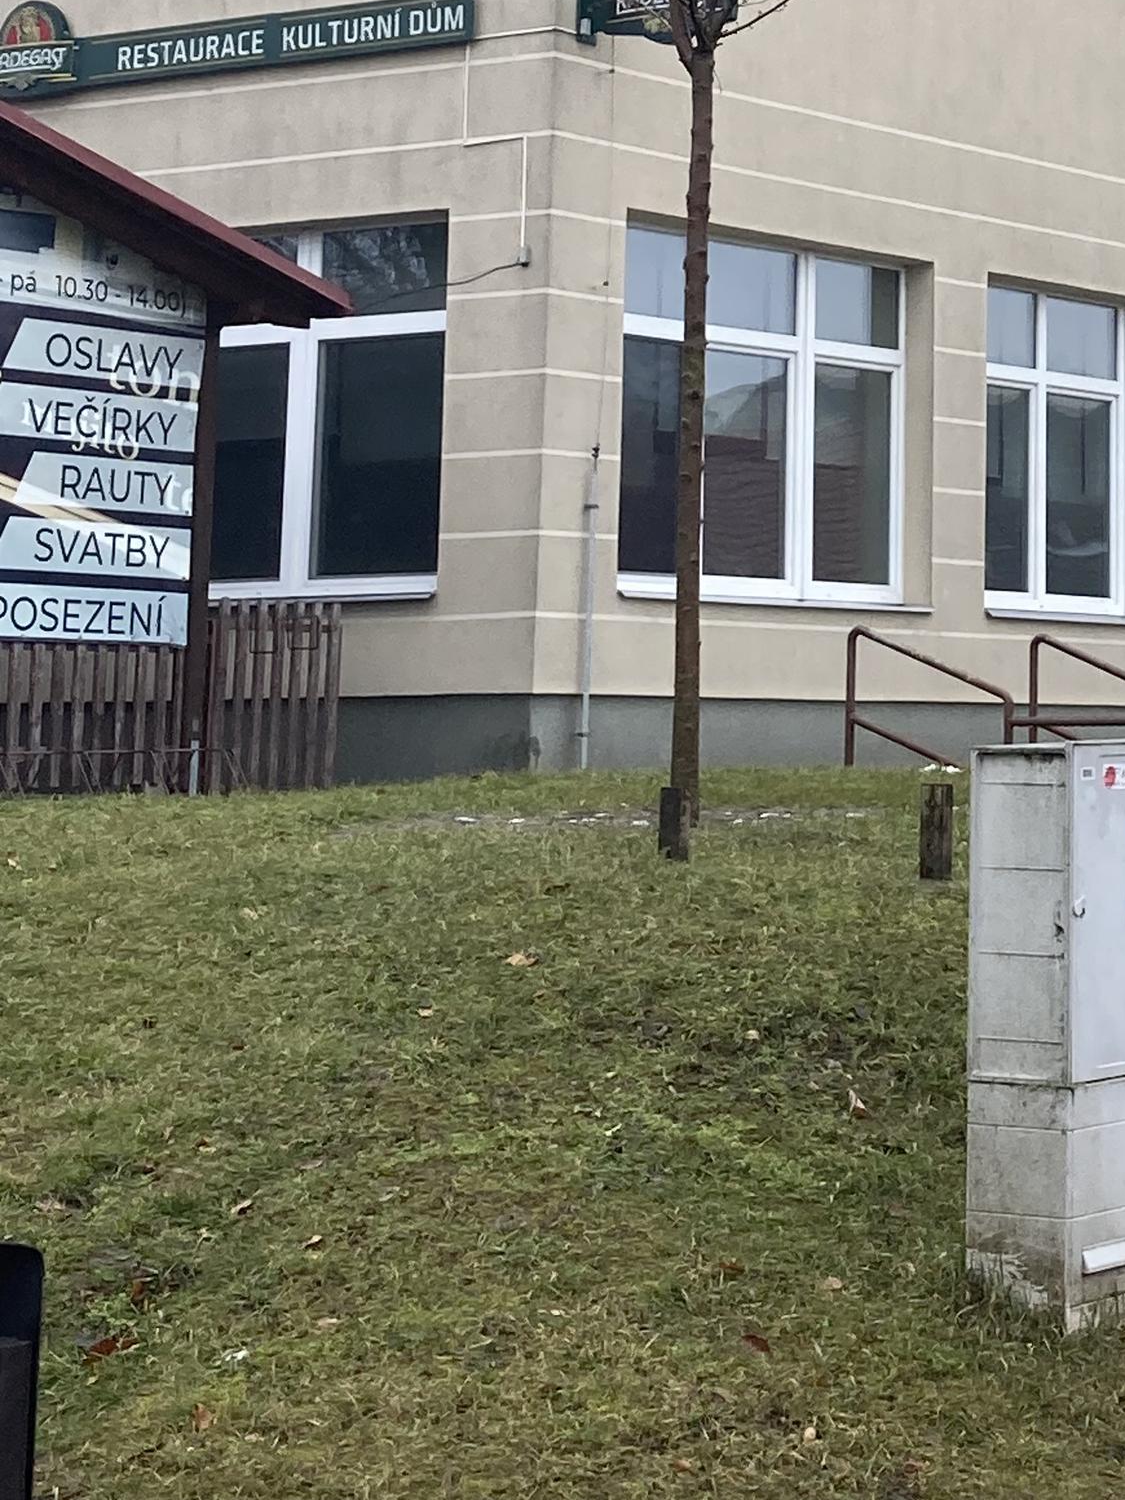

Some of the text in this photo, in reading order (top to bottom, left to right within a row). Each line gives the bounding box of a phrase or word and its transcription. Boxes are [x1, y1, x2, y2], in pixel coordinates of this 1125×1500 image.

[0, 47, 67, 71] ADEGAST
[117, 1, 465, 71] RESTAURACE KULTURNÍ DŮM
[10, 269, 37, 296] pá
[55, 274, 109, 303] 10.30
[128, 284, 186, 318] 14.00)
[45, 333, 184, 380] OSLAVY
[27, 396, 178, 446] VEČÍRKY
[60, 464, 173, 507] RAUTY
[33, 527, 170, 569] SVATBY
